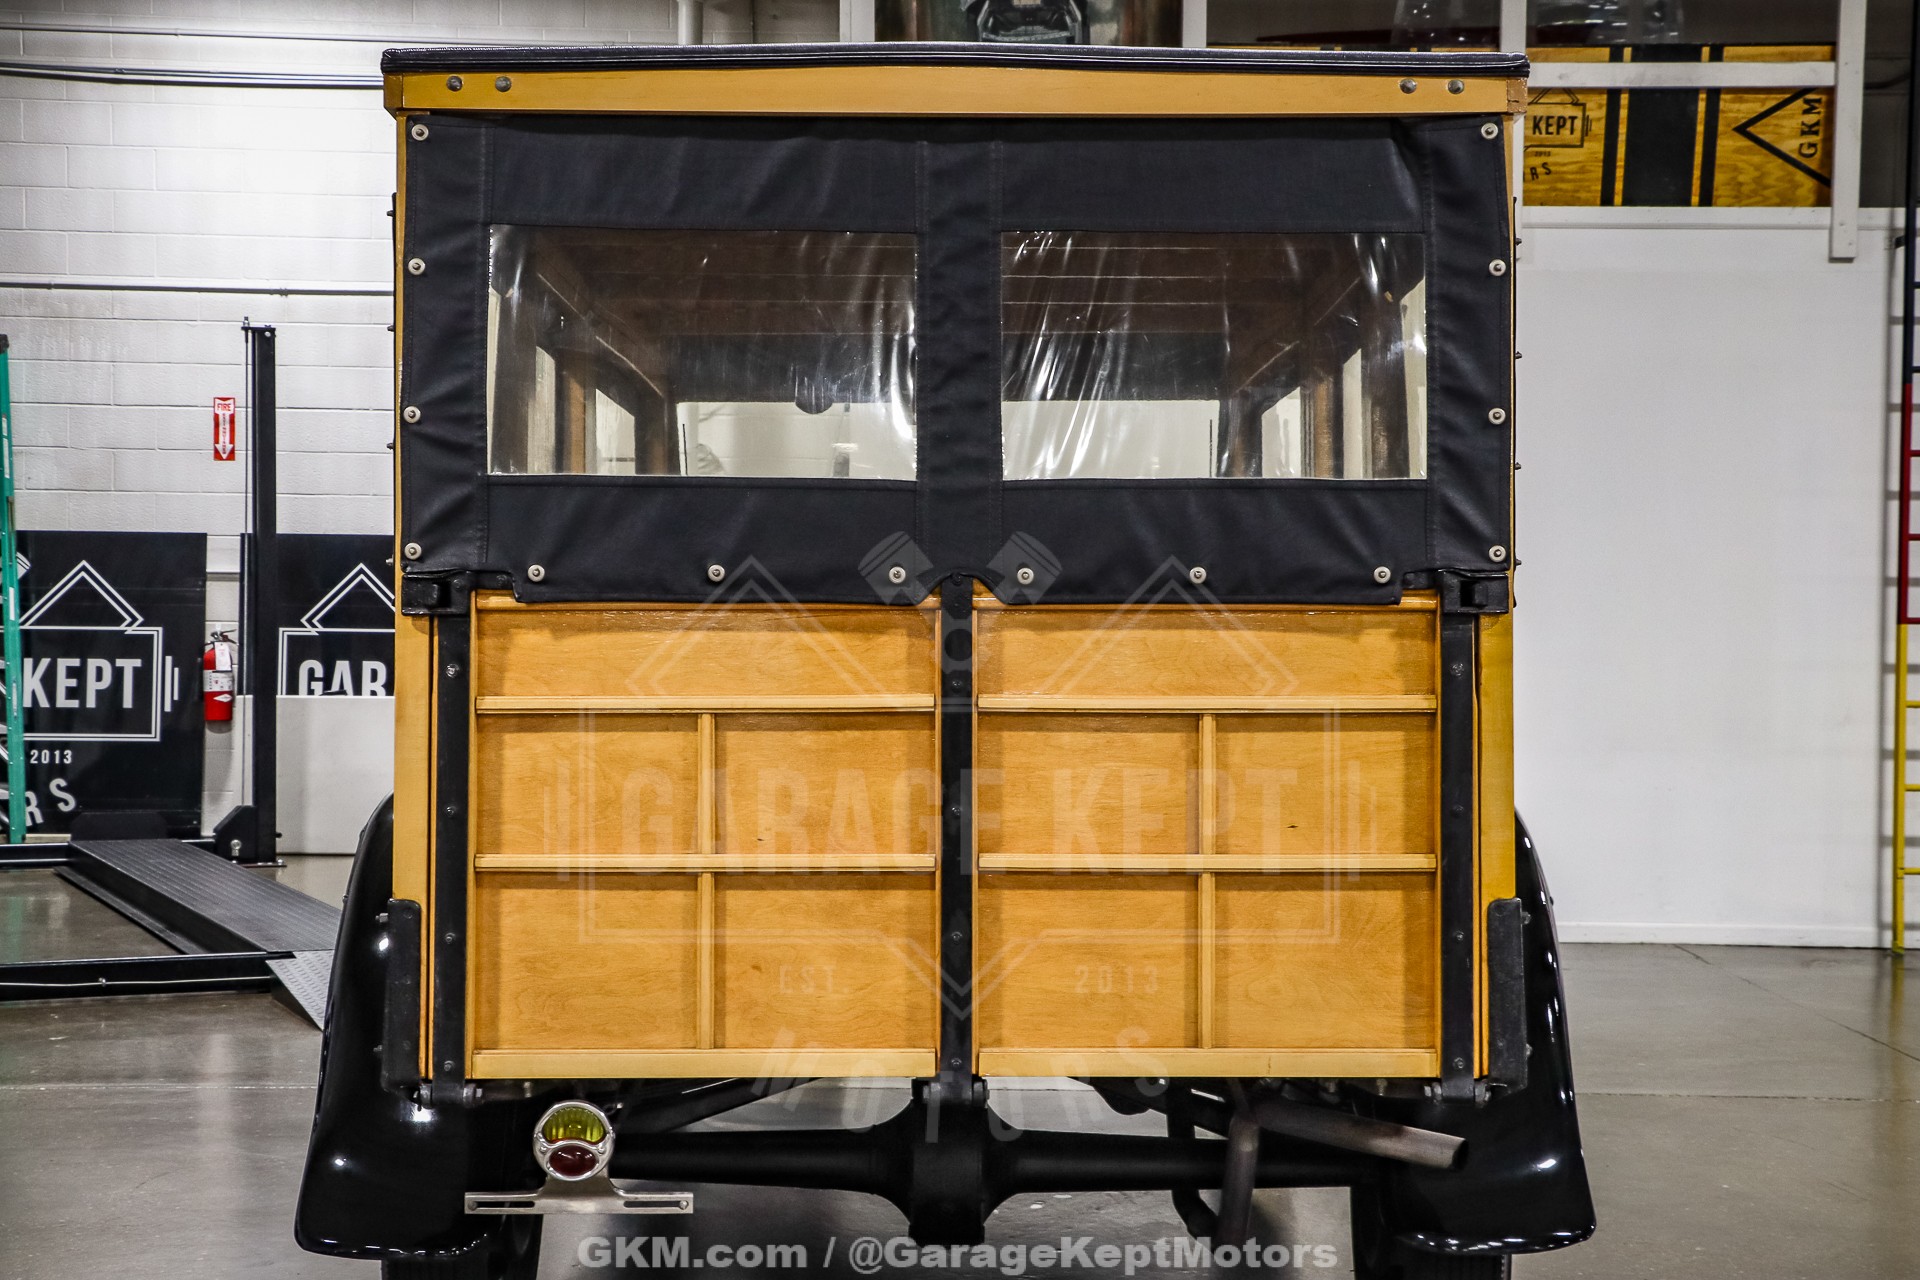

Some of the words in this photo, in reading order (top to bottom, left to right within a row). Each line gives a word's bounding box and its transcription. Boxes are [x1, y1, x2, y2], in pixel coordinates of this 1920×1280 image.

[1532, 115, 1578, 135] KEPT
[1798, 97, 1823, 158] GKM
[23, 658, 142, 708] KEPT
[30, 750, 72, 764] 2013
